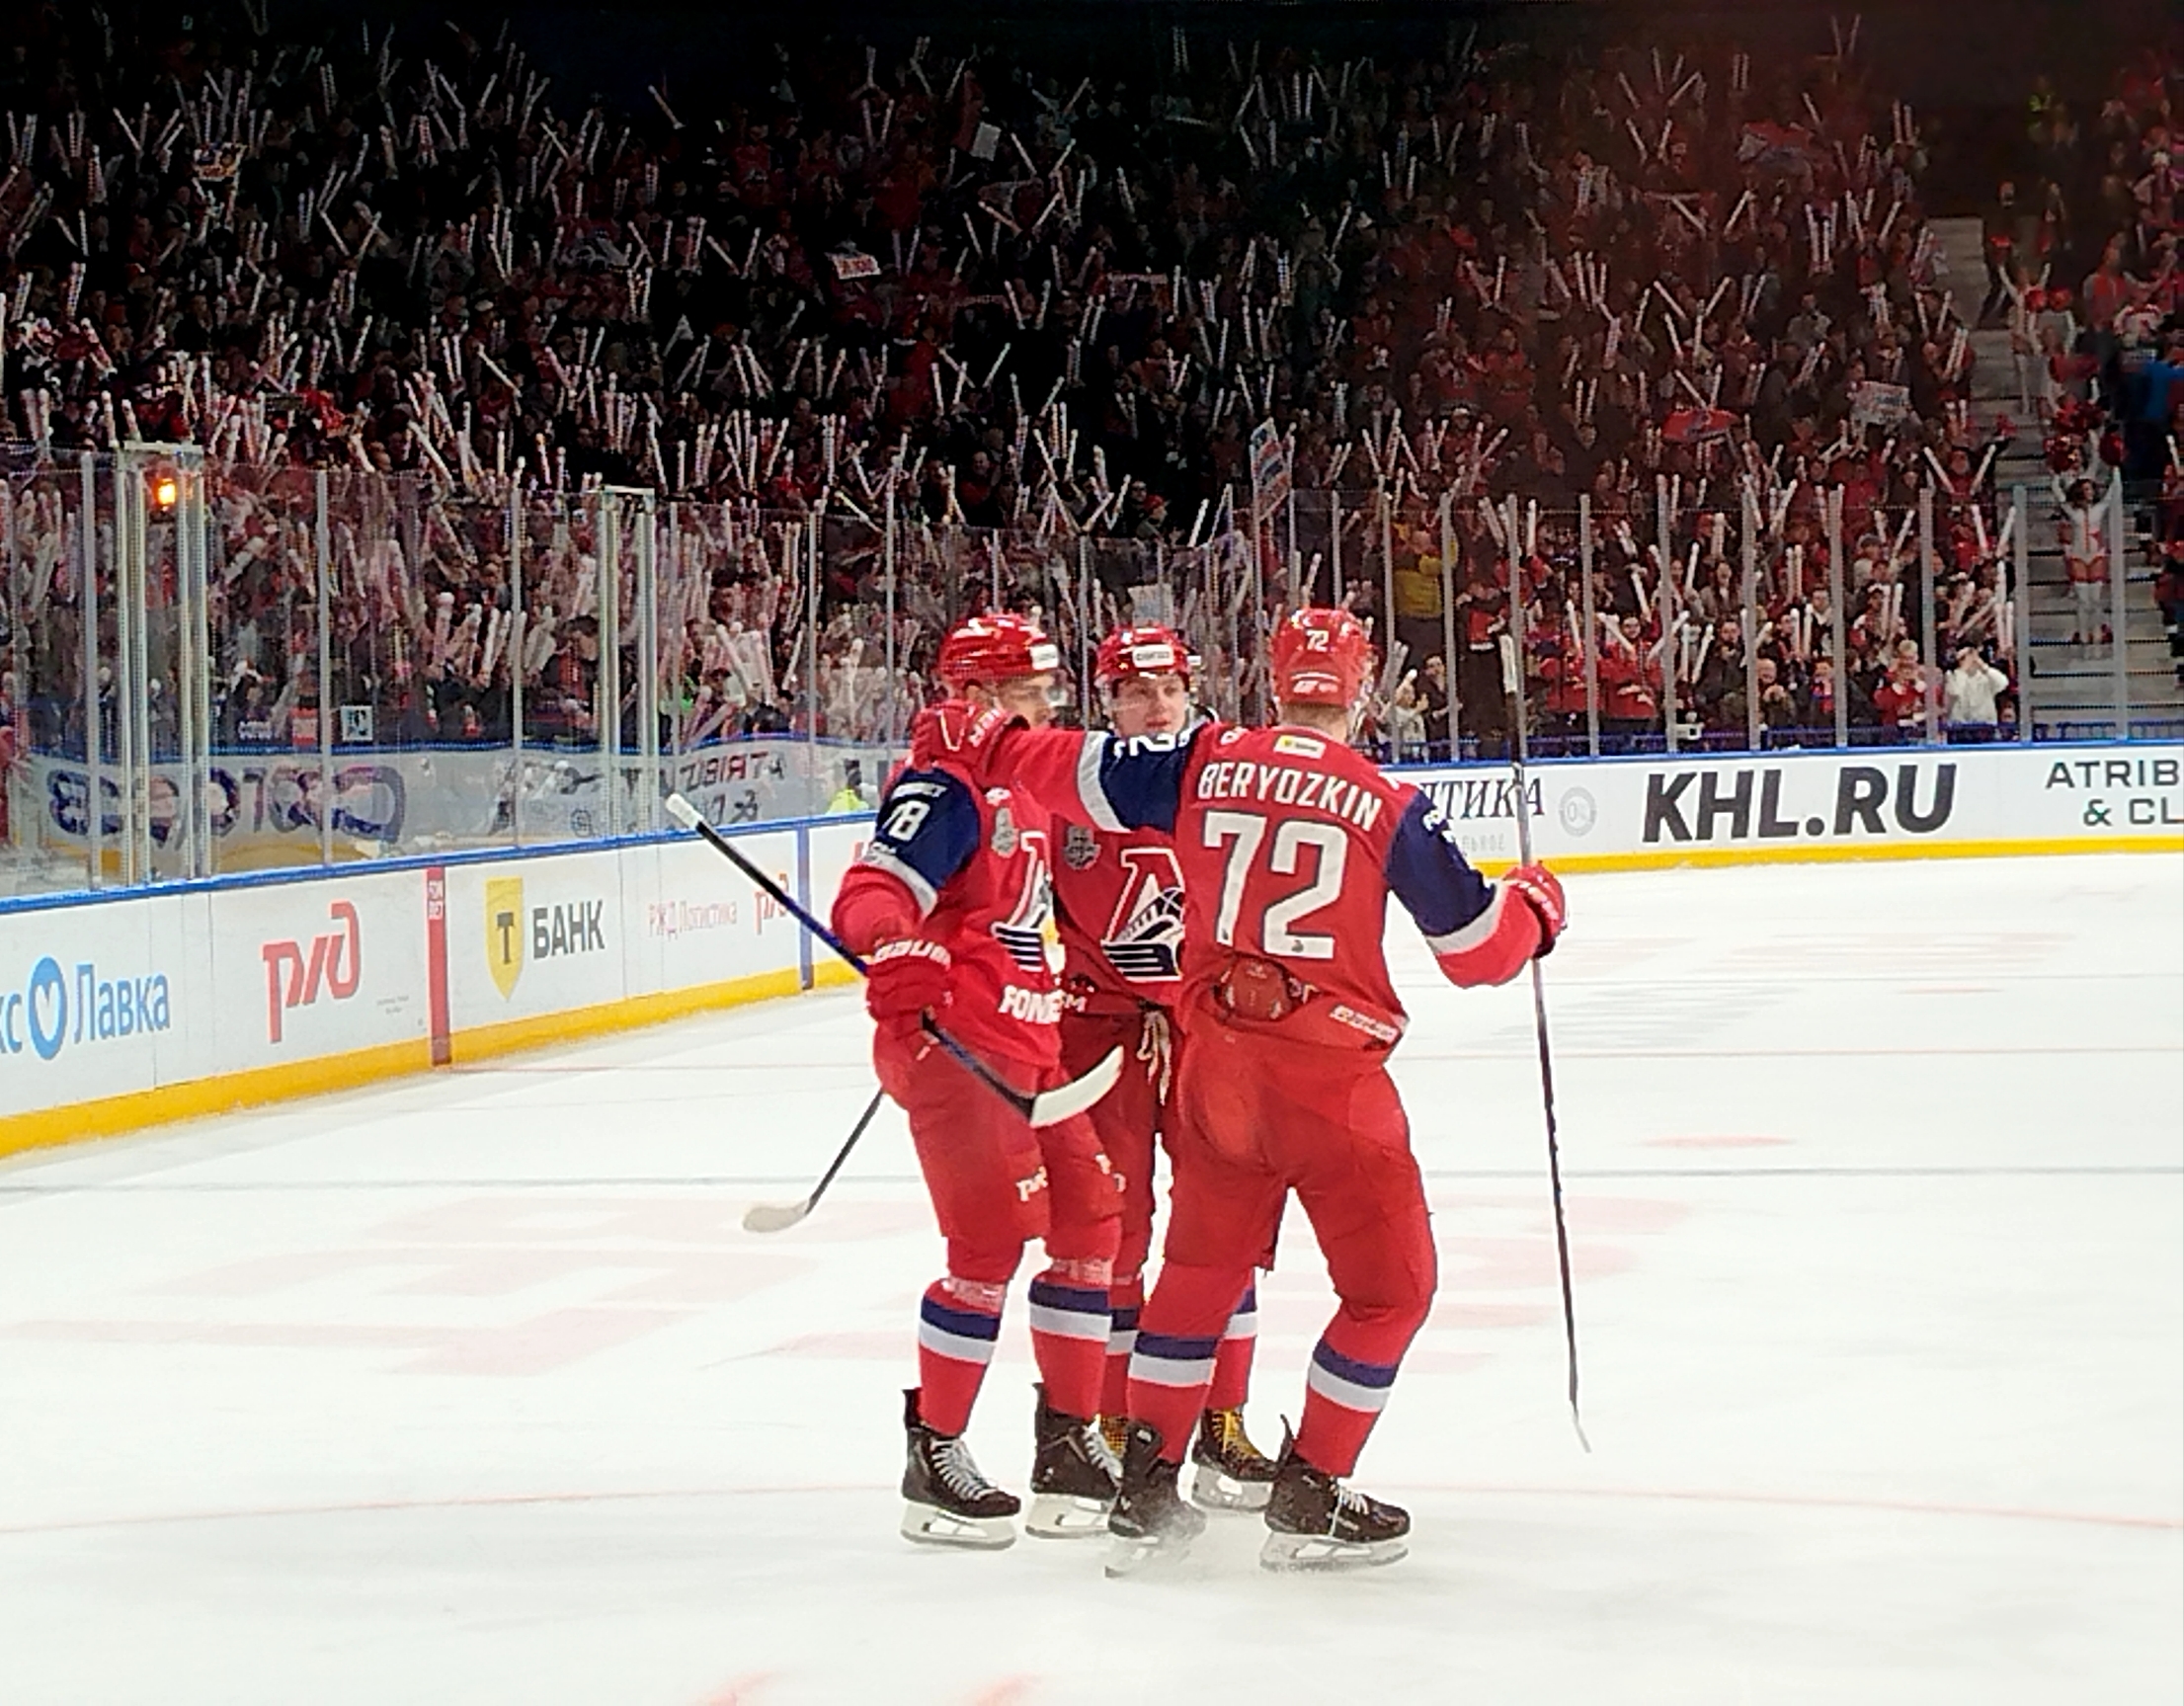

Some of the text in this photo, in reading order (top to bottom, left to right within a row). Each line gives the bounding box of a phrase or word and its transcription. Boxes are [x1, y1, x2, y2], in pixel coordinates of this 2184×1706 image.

[1305, 629, 1329, 652] 72
[1197, 762, 1382, 832] BERYOZKIN
[1642, 764, 1957, 843] KHL.RU
[2045, 760, 2179, 789] ATRIB
[2083, 798, 2113, 826] &
[1203, 810, 1348, 959] 72
[533, 900, 606, 959] БАНК
[74, 963, 170, 1044] Лавка
